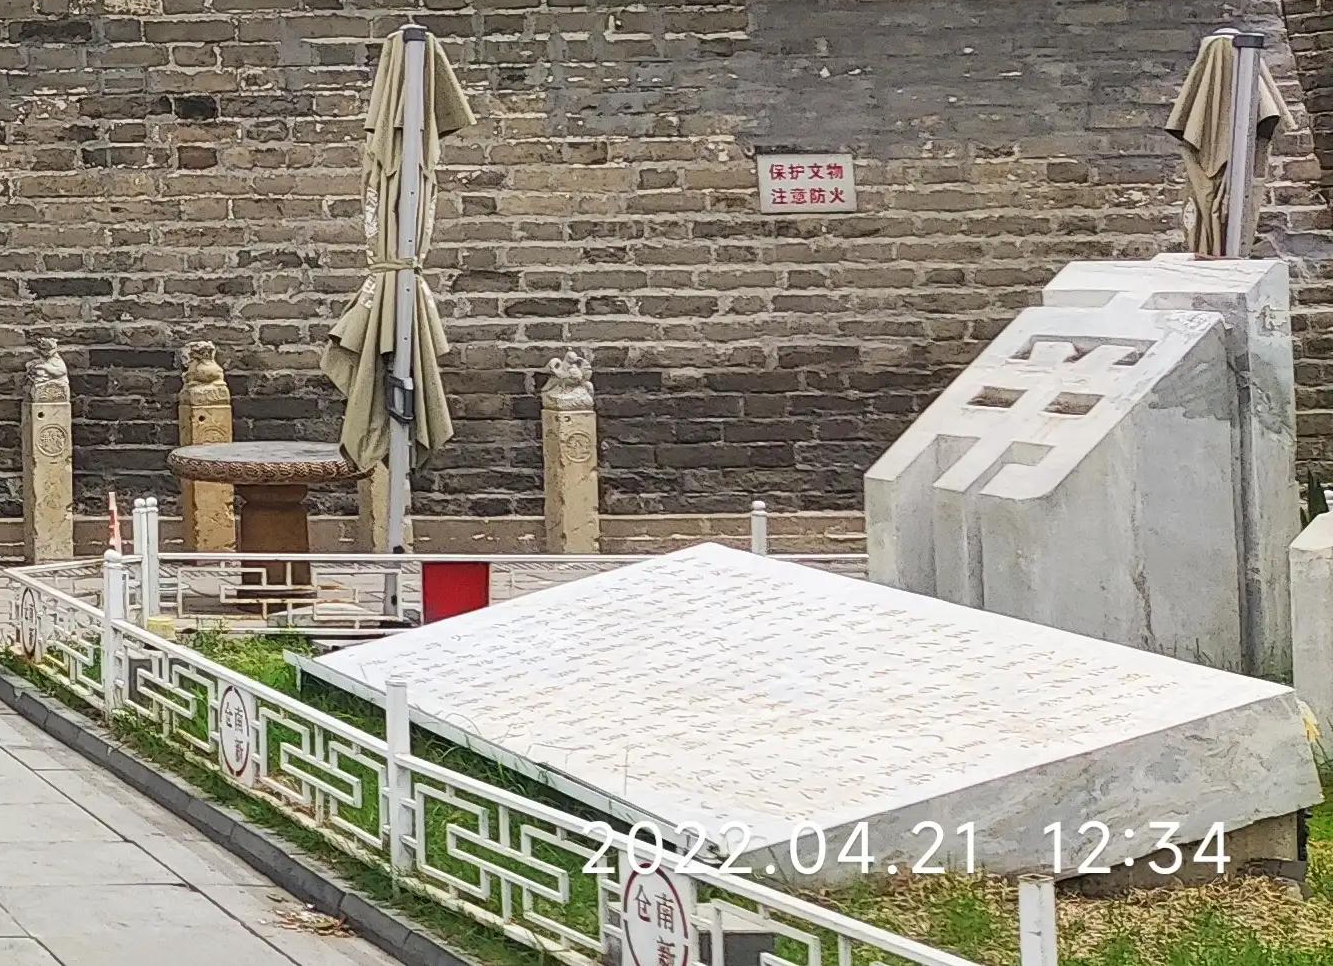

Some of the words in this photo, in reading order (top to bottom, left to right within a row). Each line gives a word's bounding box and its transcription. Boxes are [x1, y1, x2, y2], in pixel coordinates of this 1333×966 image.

[769, 163, 844, 181] 保护文物
[771, 187, 846, 205] 注意防火
